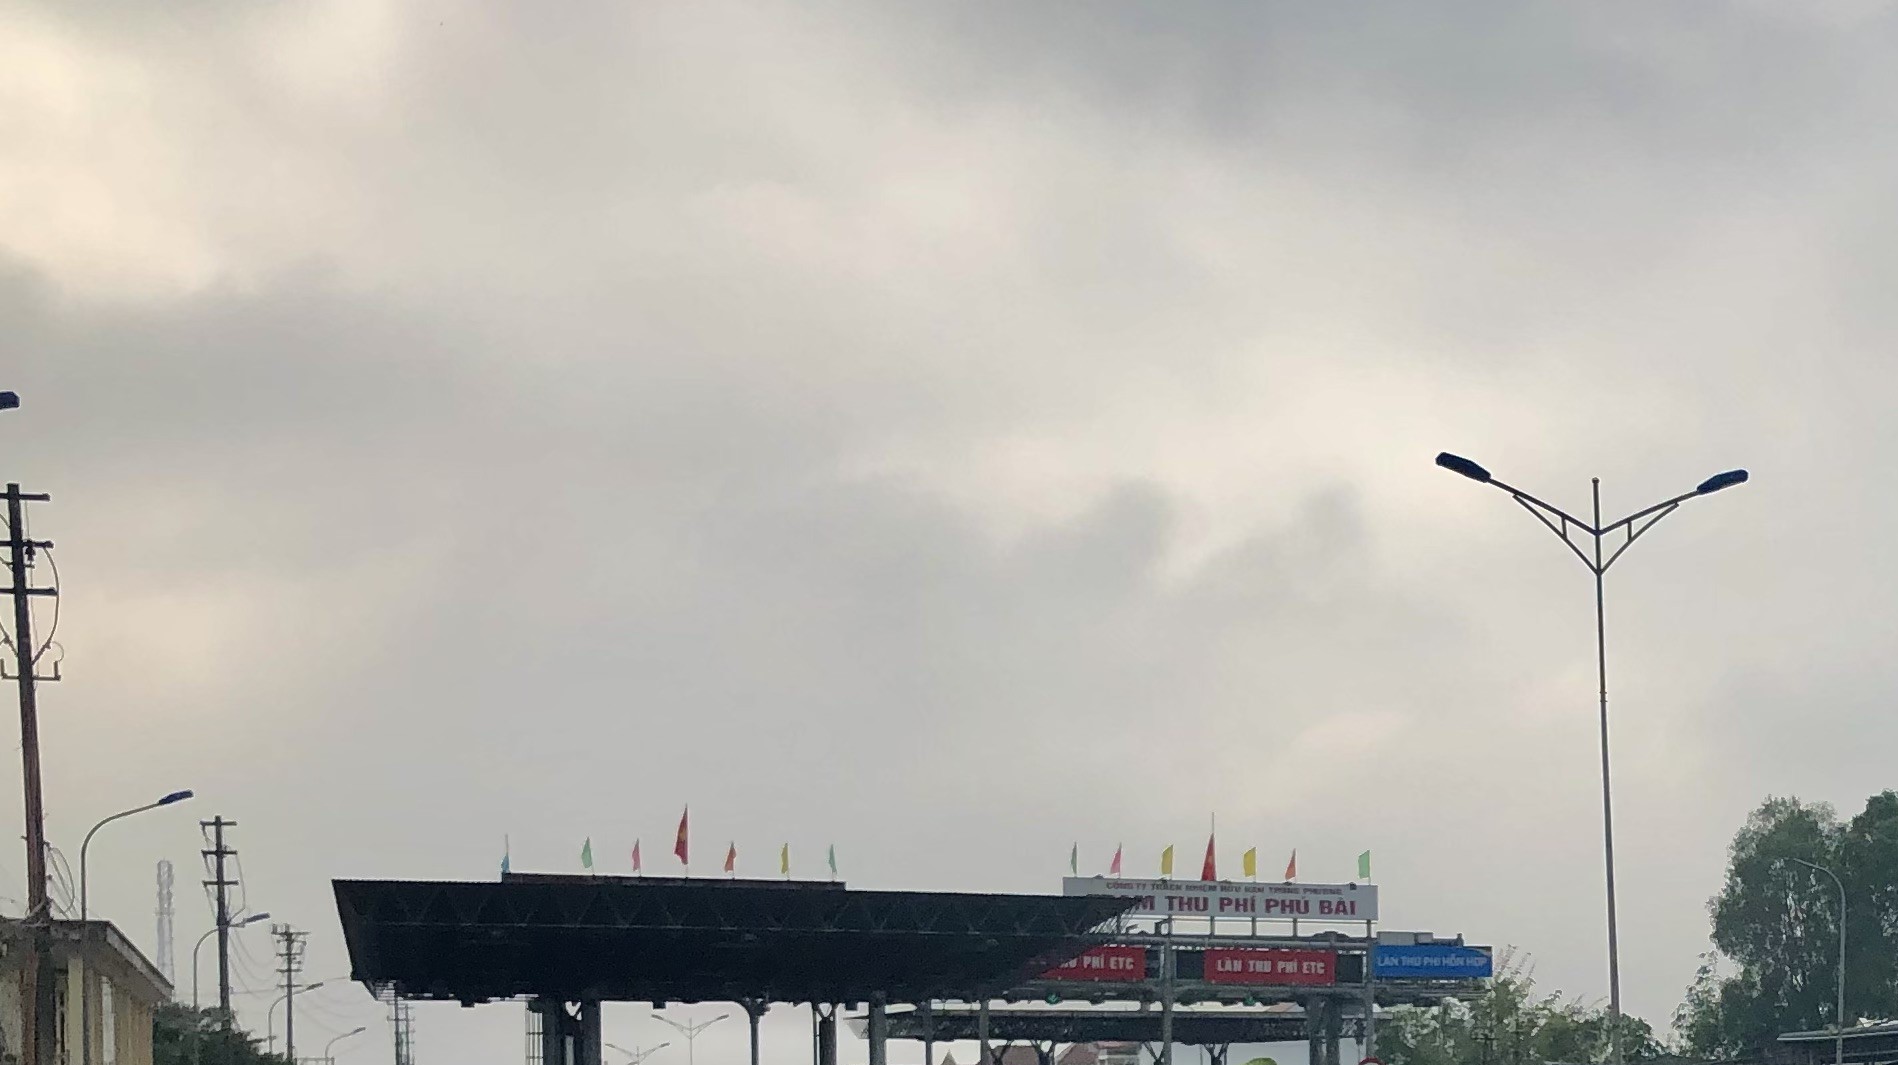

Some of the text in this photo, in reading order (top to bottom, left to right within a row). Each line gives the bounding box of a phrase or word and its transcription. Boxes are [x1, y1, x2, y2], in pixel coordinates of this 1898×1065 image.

[1164, 895, 1209, 912] THU
[1219, 895, 1256, 913] PHÍ
[1265, 896, 1310, 915] PHÚ
[1319, 897, 1356, 916] BÀI
[1109, 956, 1134, 970] ETC
[1302, 961, 1325, 975] ETC
